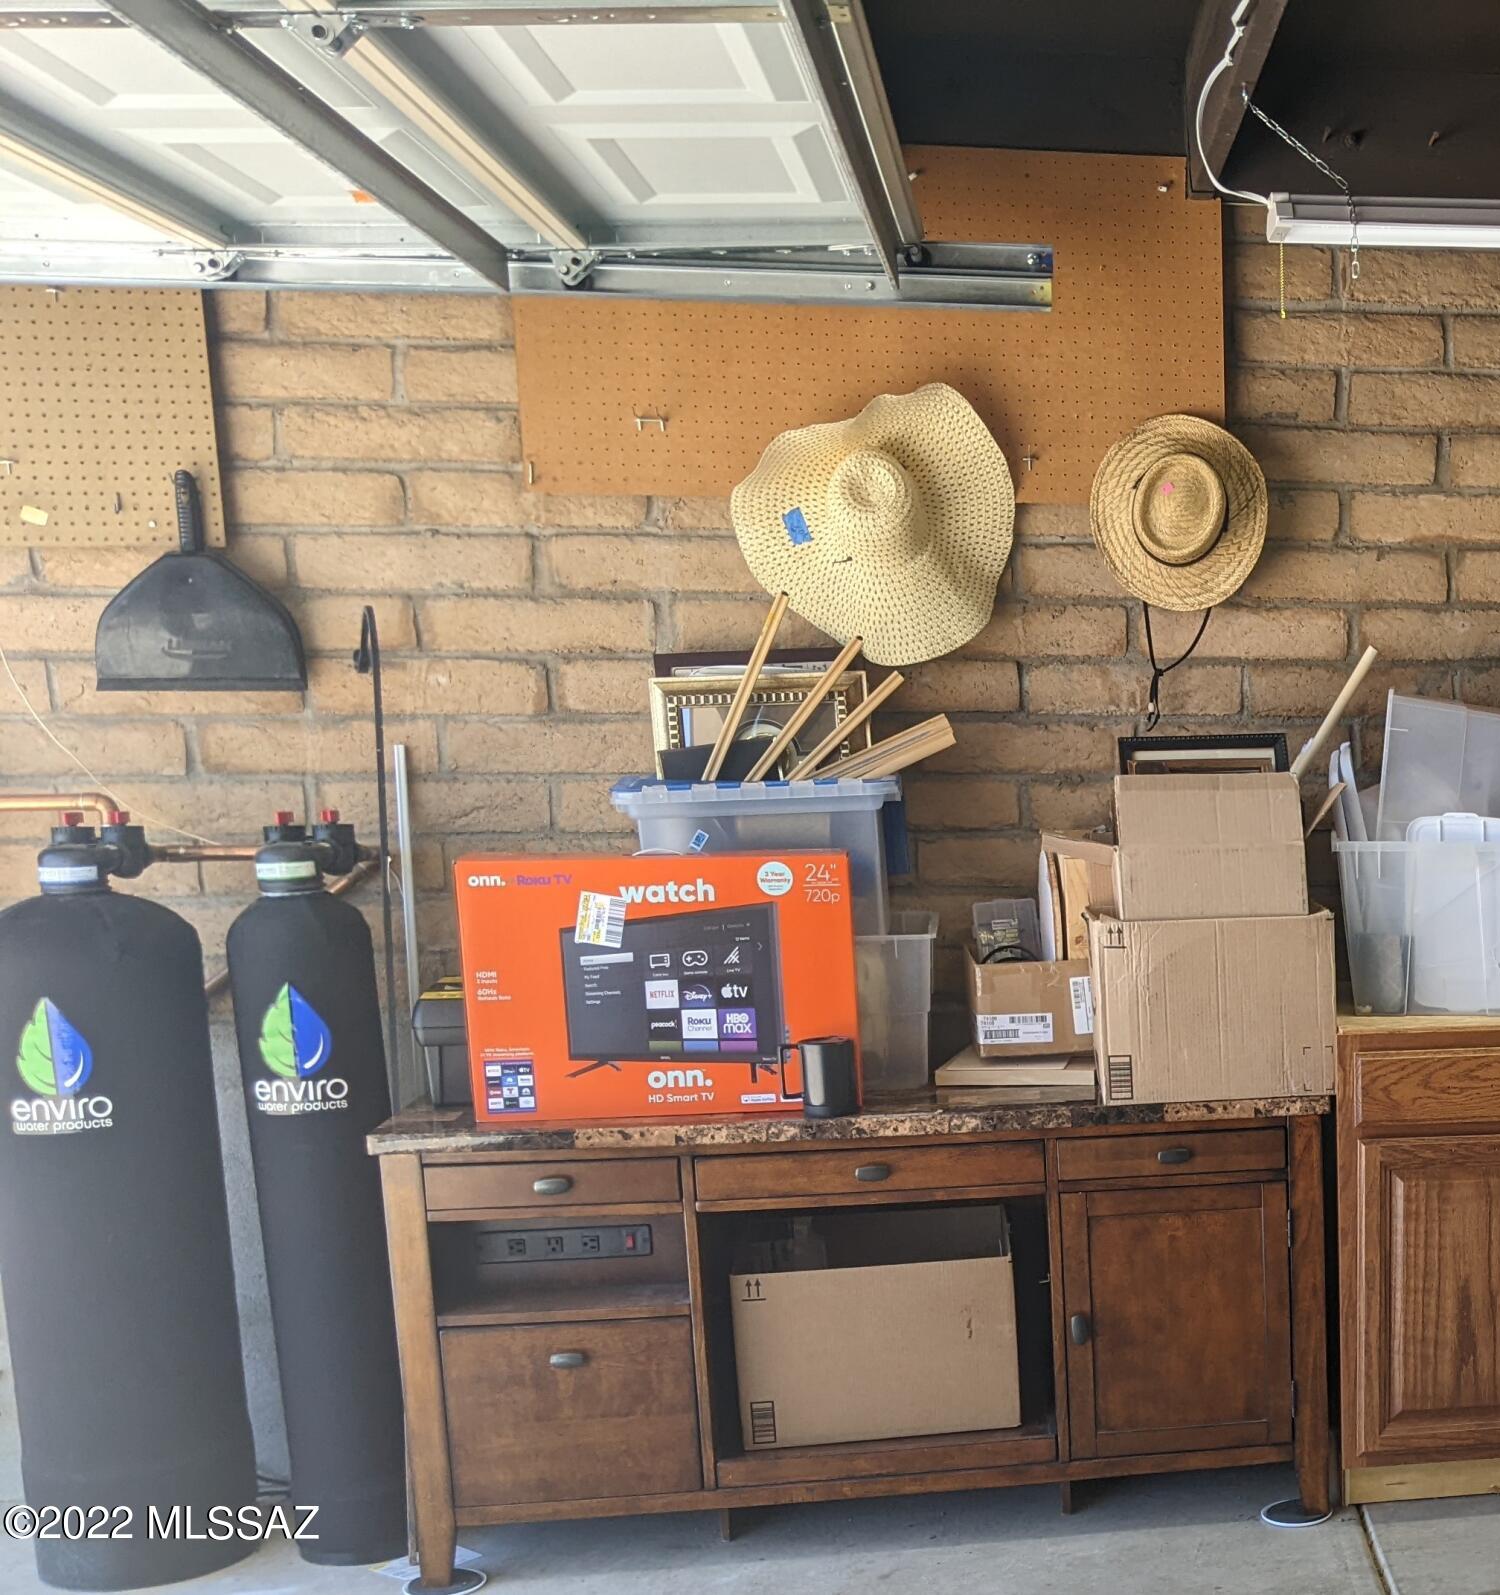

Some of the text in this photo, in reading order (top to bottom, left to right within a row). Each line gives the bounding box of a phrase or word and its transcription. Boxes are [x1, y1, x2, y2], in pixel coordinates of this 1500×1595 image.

[468, 874, 573, 887] onn. Roku TV
[619, 878, 715, 904] watch
[804, 888, 841, 905] 720p
[649, 990, 675, 999] NETFLIX
[651, 1020, 676, 1030] peacock
[687, 1016, 711, 1025] Roku
[726, 1013, 749, 1024] HBO
[723, 1023, 752, 1034] max
[647, 1069, 713, 1089] onn.
[255, 1078, 348, 1102] enviro
[648, 1092, 714, 1103] HD Smart TV
[10, 1096, 113, 1122] enviro
[258, 1099, 348, 1114] water products
[16, 1118, 113, 1134] water products
